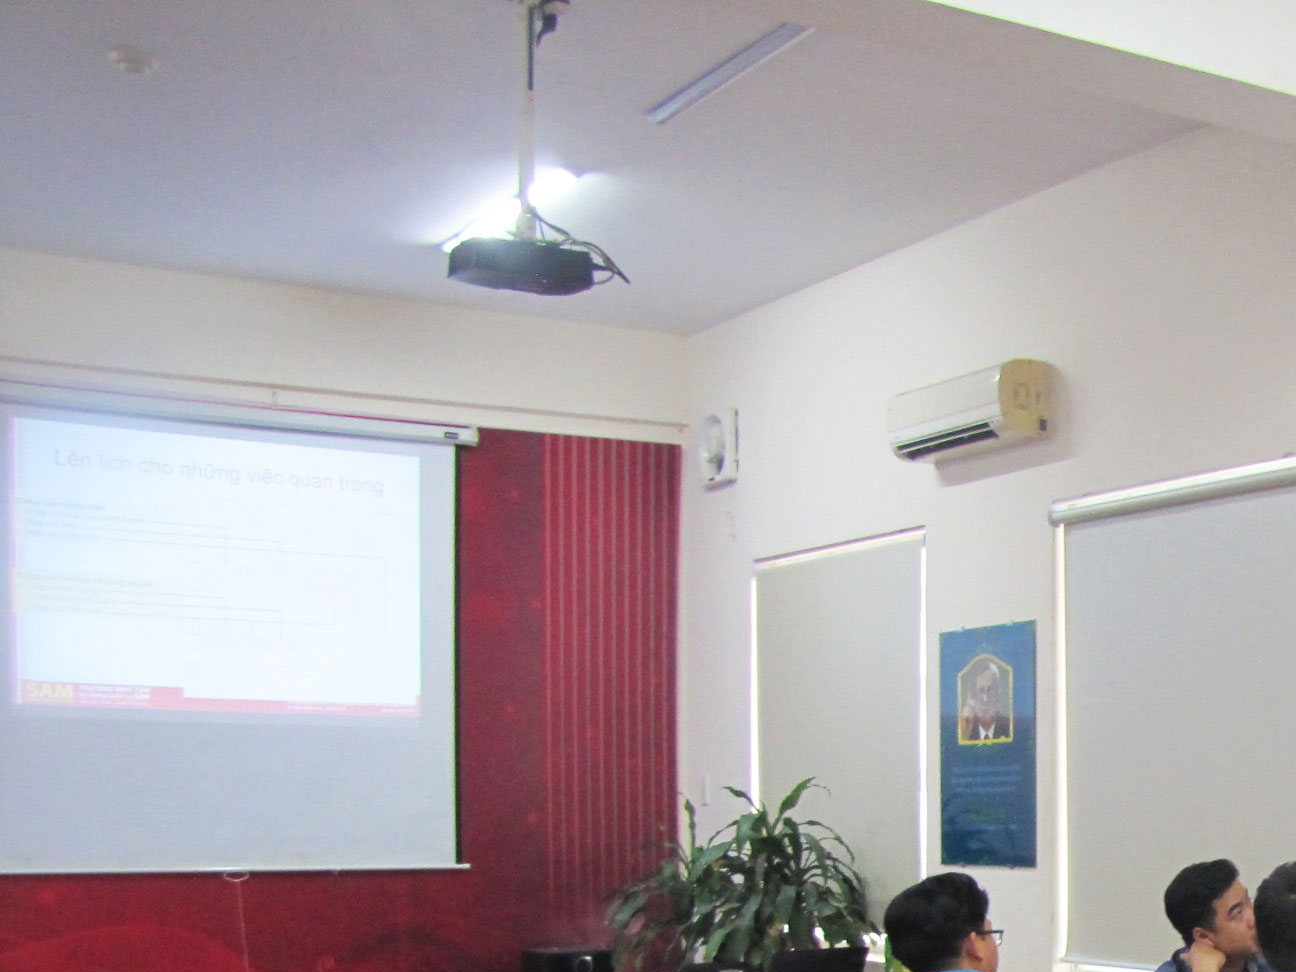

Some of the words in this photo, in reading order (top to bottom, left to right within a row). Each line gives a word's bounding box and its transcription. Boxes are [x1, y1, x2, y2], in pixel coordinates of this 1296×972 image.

[54, 448, 92, 468] Lên
[138, 457, 173, 475] cho
[26, 682, 74, 698] SAM
